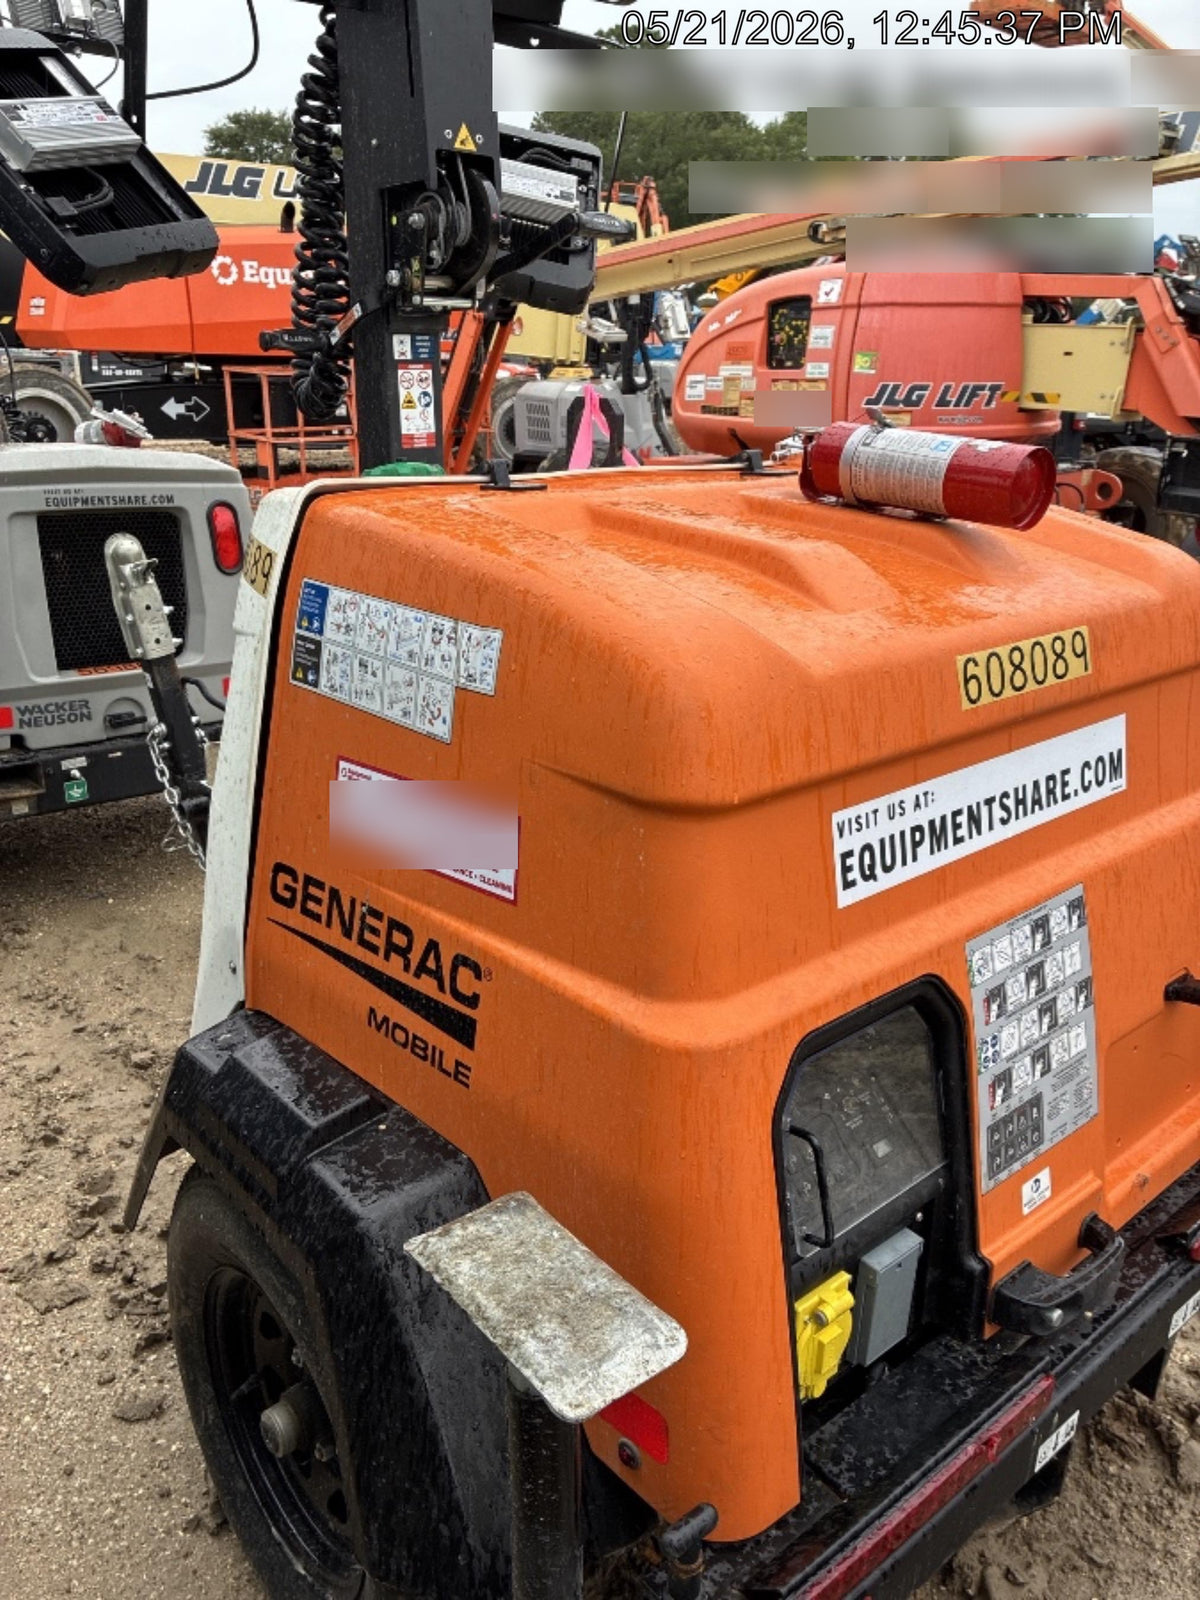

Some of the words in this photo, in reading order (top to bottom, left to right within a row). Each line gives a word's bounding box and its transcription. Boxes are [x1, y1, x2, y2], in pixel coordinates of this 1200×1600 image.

[184, 160, 266, 199] JLG
[862, 382, 932, 409] JLG
[932, 382, 1006, 410] LIFT
[45, 494, 175, 508] EQUIPMENTSHARE.COM
[962, 629, 1089, 705] 608089
[16, 699, 91, 717] WACKER
[18, 711, 93, 730] NEUSON
[836, 808, 880, 840] VISIT
[886, 799, 907, 822] US
[912, 791, 936, 813] AT:
[839, 747, 1124, 892] EQUIPMENTSHARE.COM
[269, 861, 483, 1011] GENERAC
[367, 1006, 472, 1090] MOBILE
